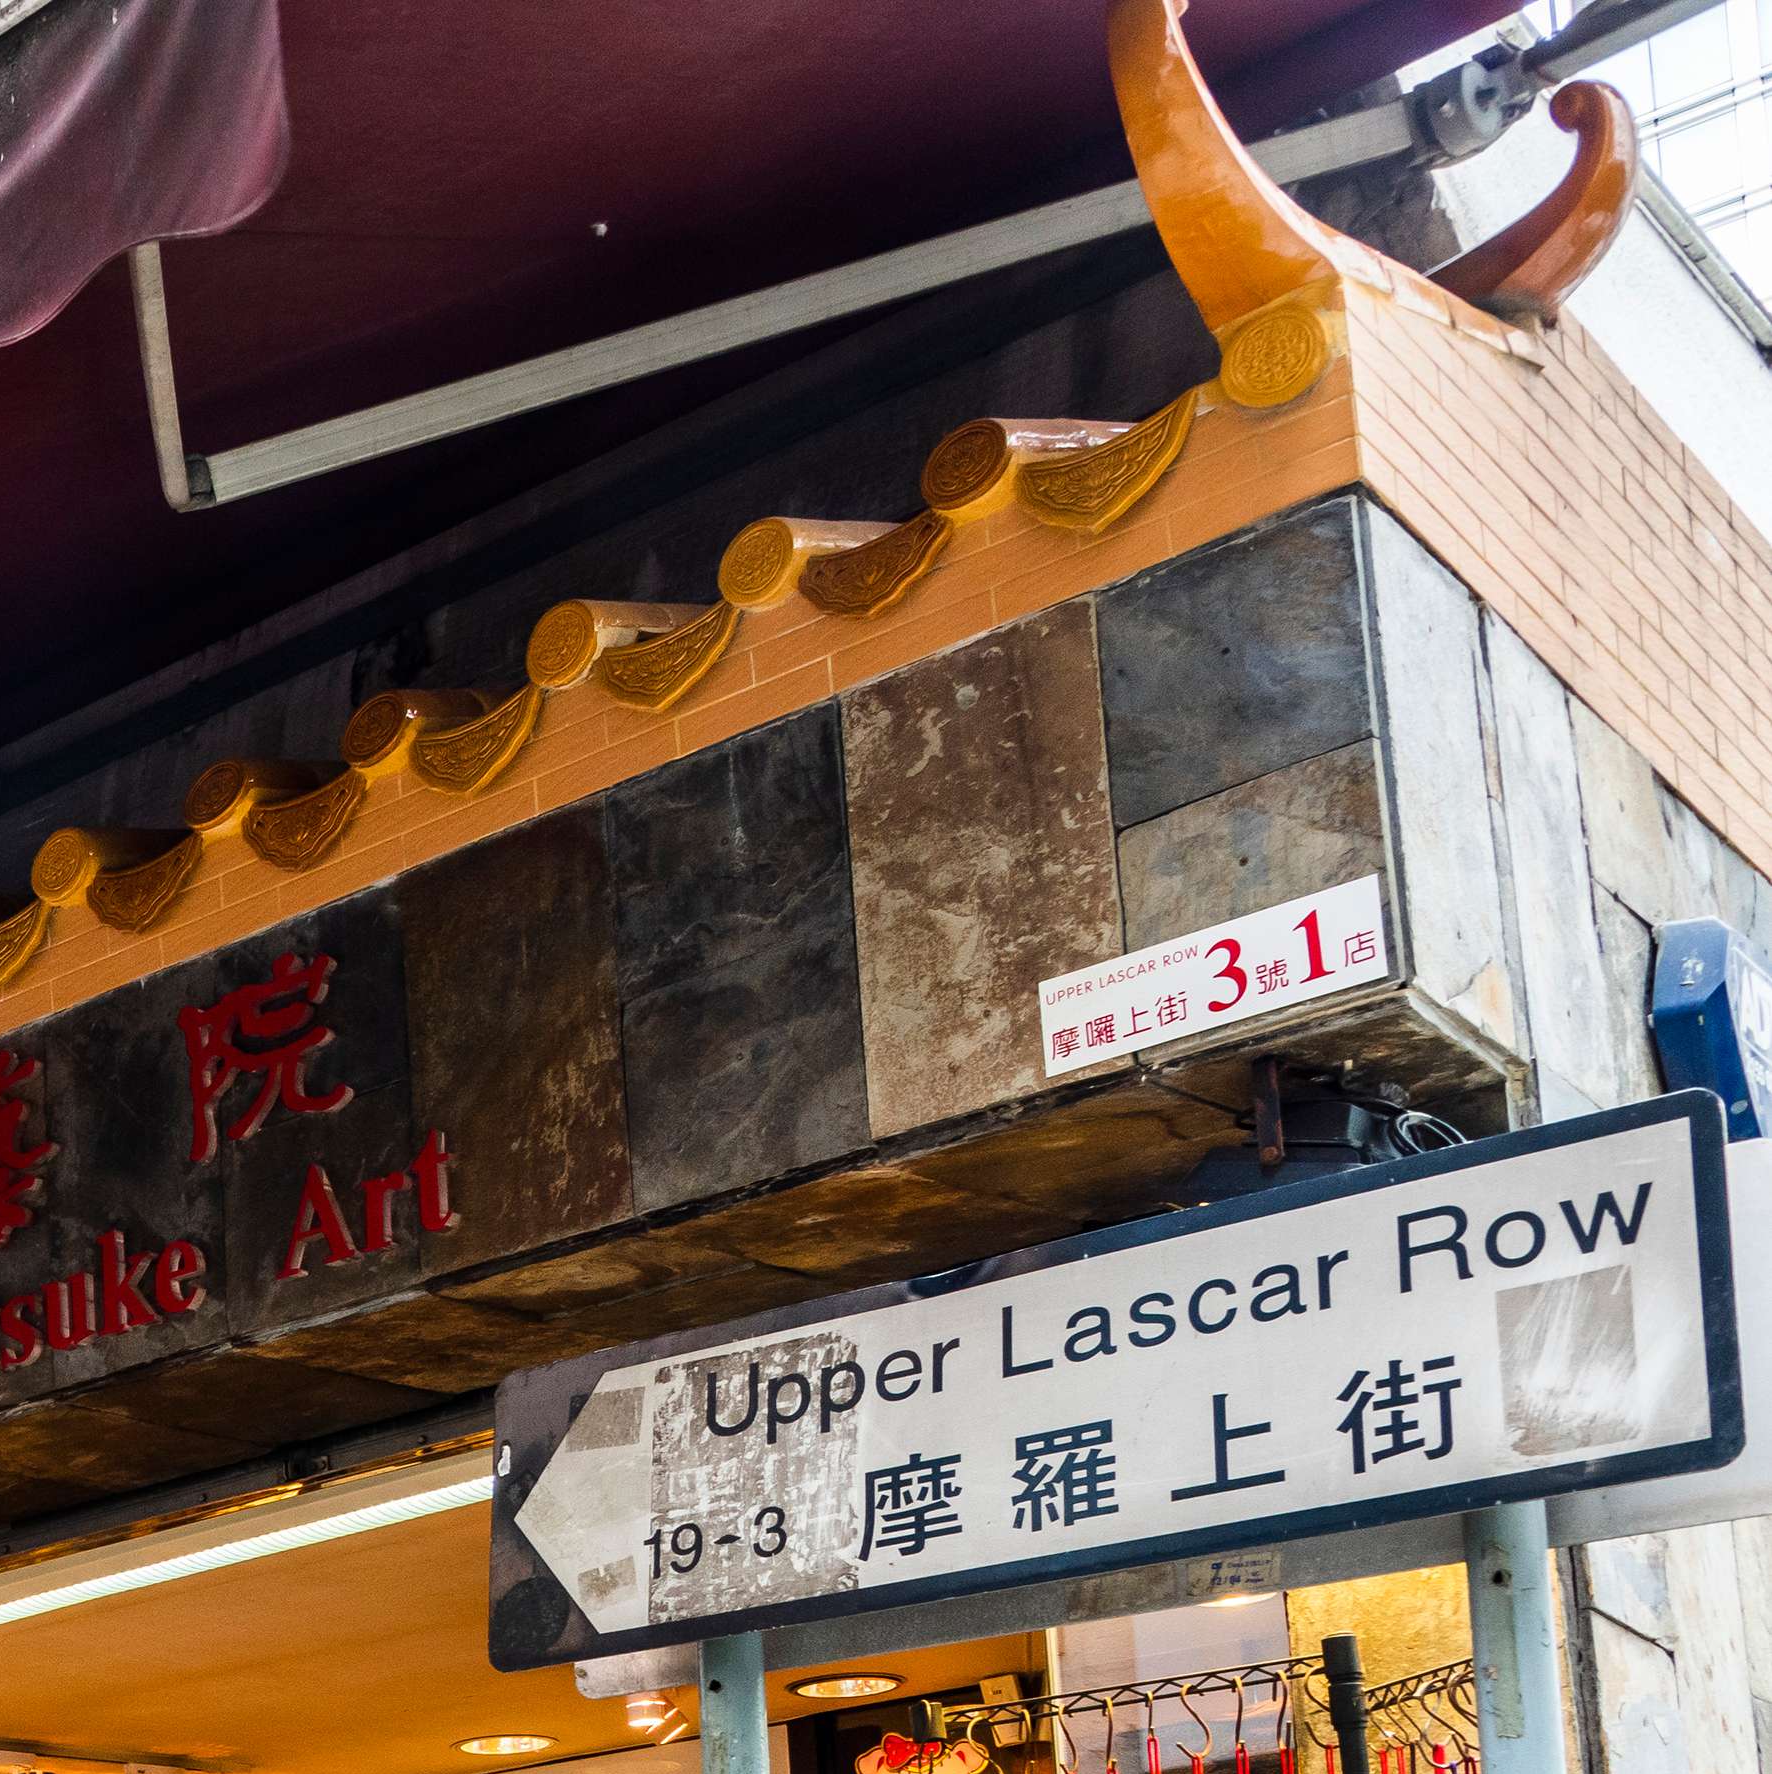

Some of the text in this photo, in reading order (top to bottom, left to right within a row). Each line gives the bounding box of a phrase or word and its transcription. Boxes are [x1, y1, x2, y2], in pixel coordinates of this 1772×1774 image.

[1045, 944, 1199, 1006] UPPER LASCAR ROW
[279, 1128, 454, 1280] Art
[706, 1180, 1655, 1443] Upper Lascar Row
[857, 1355, 1461, 1563] 摩羅上街
